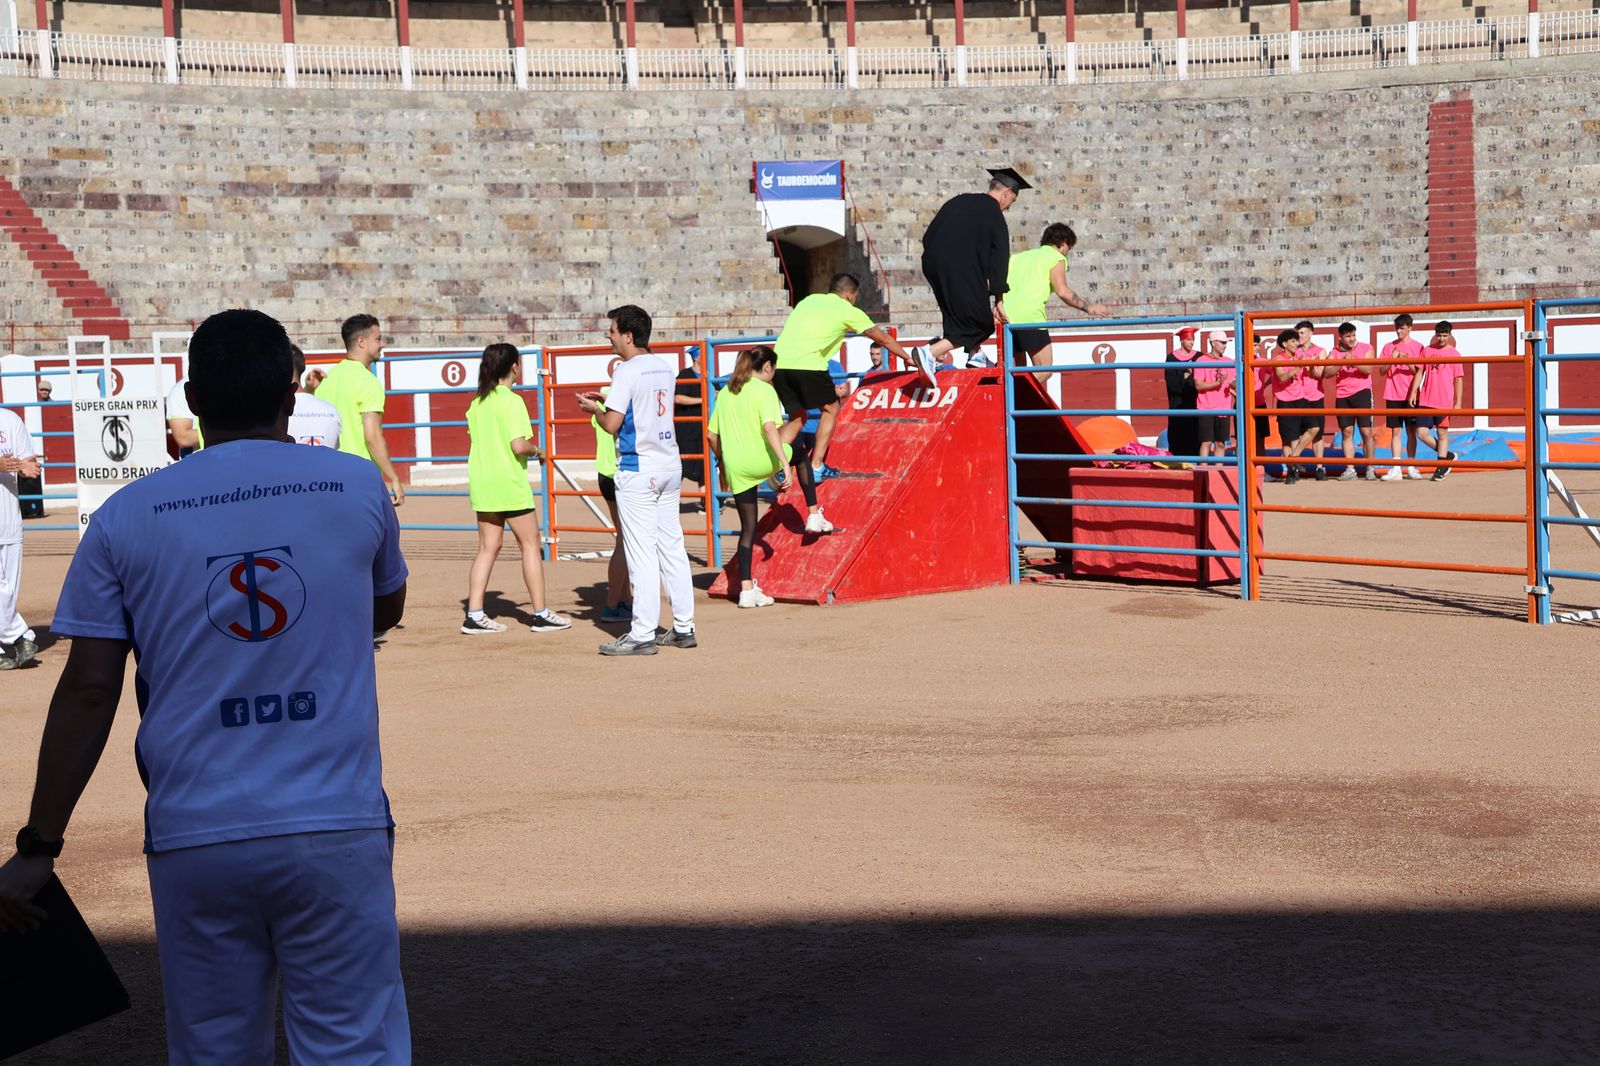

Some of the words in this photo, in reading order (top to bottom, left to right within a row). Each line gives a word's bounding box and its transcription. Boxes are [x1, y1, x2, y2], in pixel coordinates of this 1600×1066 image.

[777, 173, 837, 187] TAUROEMOCIÓN
[447, 364, 460, 384] 6
[107, 400, 134, 411] GRAN
[136, 400, 158, 410] PRIX
[852, 386, 959, 410] SALIDA
[79, 467, 118, 479] RUEDO
[153, 479, 345, 515] www.ruedobravo.com
